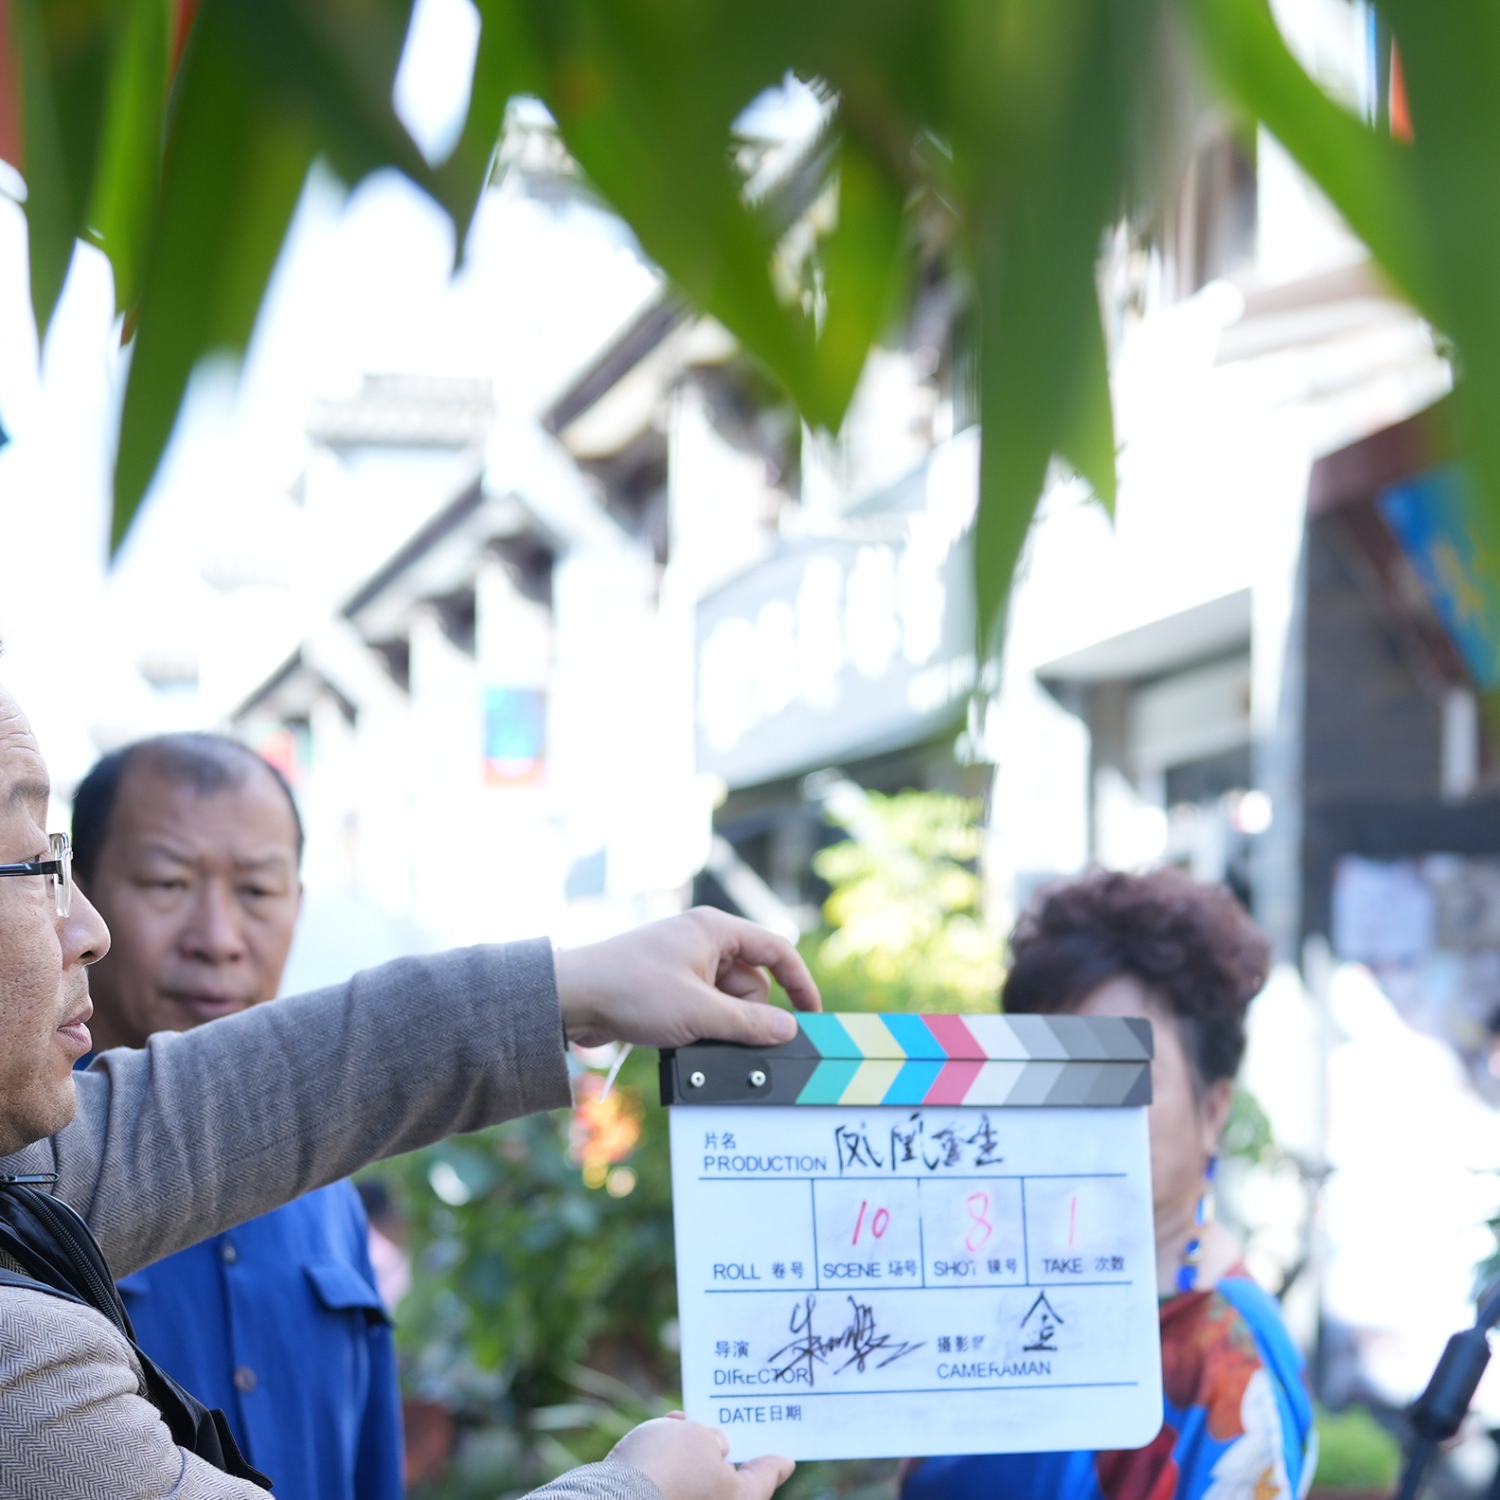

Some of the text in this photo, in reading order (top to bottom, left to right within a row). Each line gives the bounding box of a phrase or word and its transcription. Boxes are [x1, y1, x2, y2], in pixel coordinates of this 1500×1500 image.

[705, 1132, 737, 1150] 片名
[704, 1156, 827, 1172] PRODUCTION
[852, 1200, 890, 1246] 10
[965, 1192, 994, 1252] 8
[1068, 1195, 1077, 1247] 1
[713, 1262, 805, 1280] ROLL 卷号
[823, 1260, 917, 1279] SCENE 场号
[988, 1258, 1018, 1275] 镜号
[1042, 1255, 1125, 1275] TAKE 次数
[714, 1340, 750, 1358] 导演
[714, 1368, 809, 1386] DIRECTOR
[937, 1360, 1052, 1380] CAMERAMAN
[719, 1405, 802, 1425] DATE 日期
